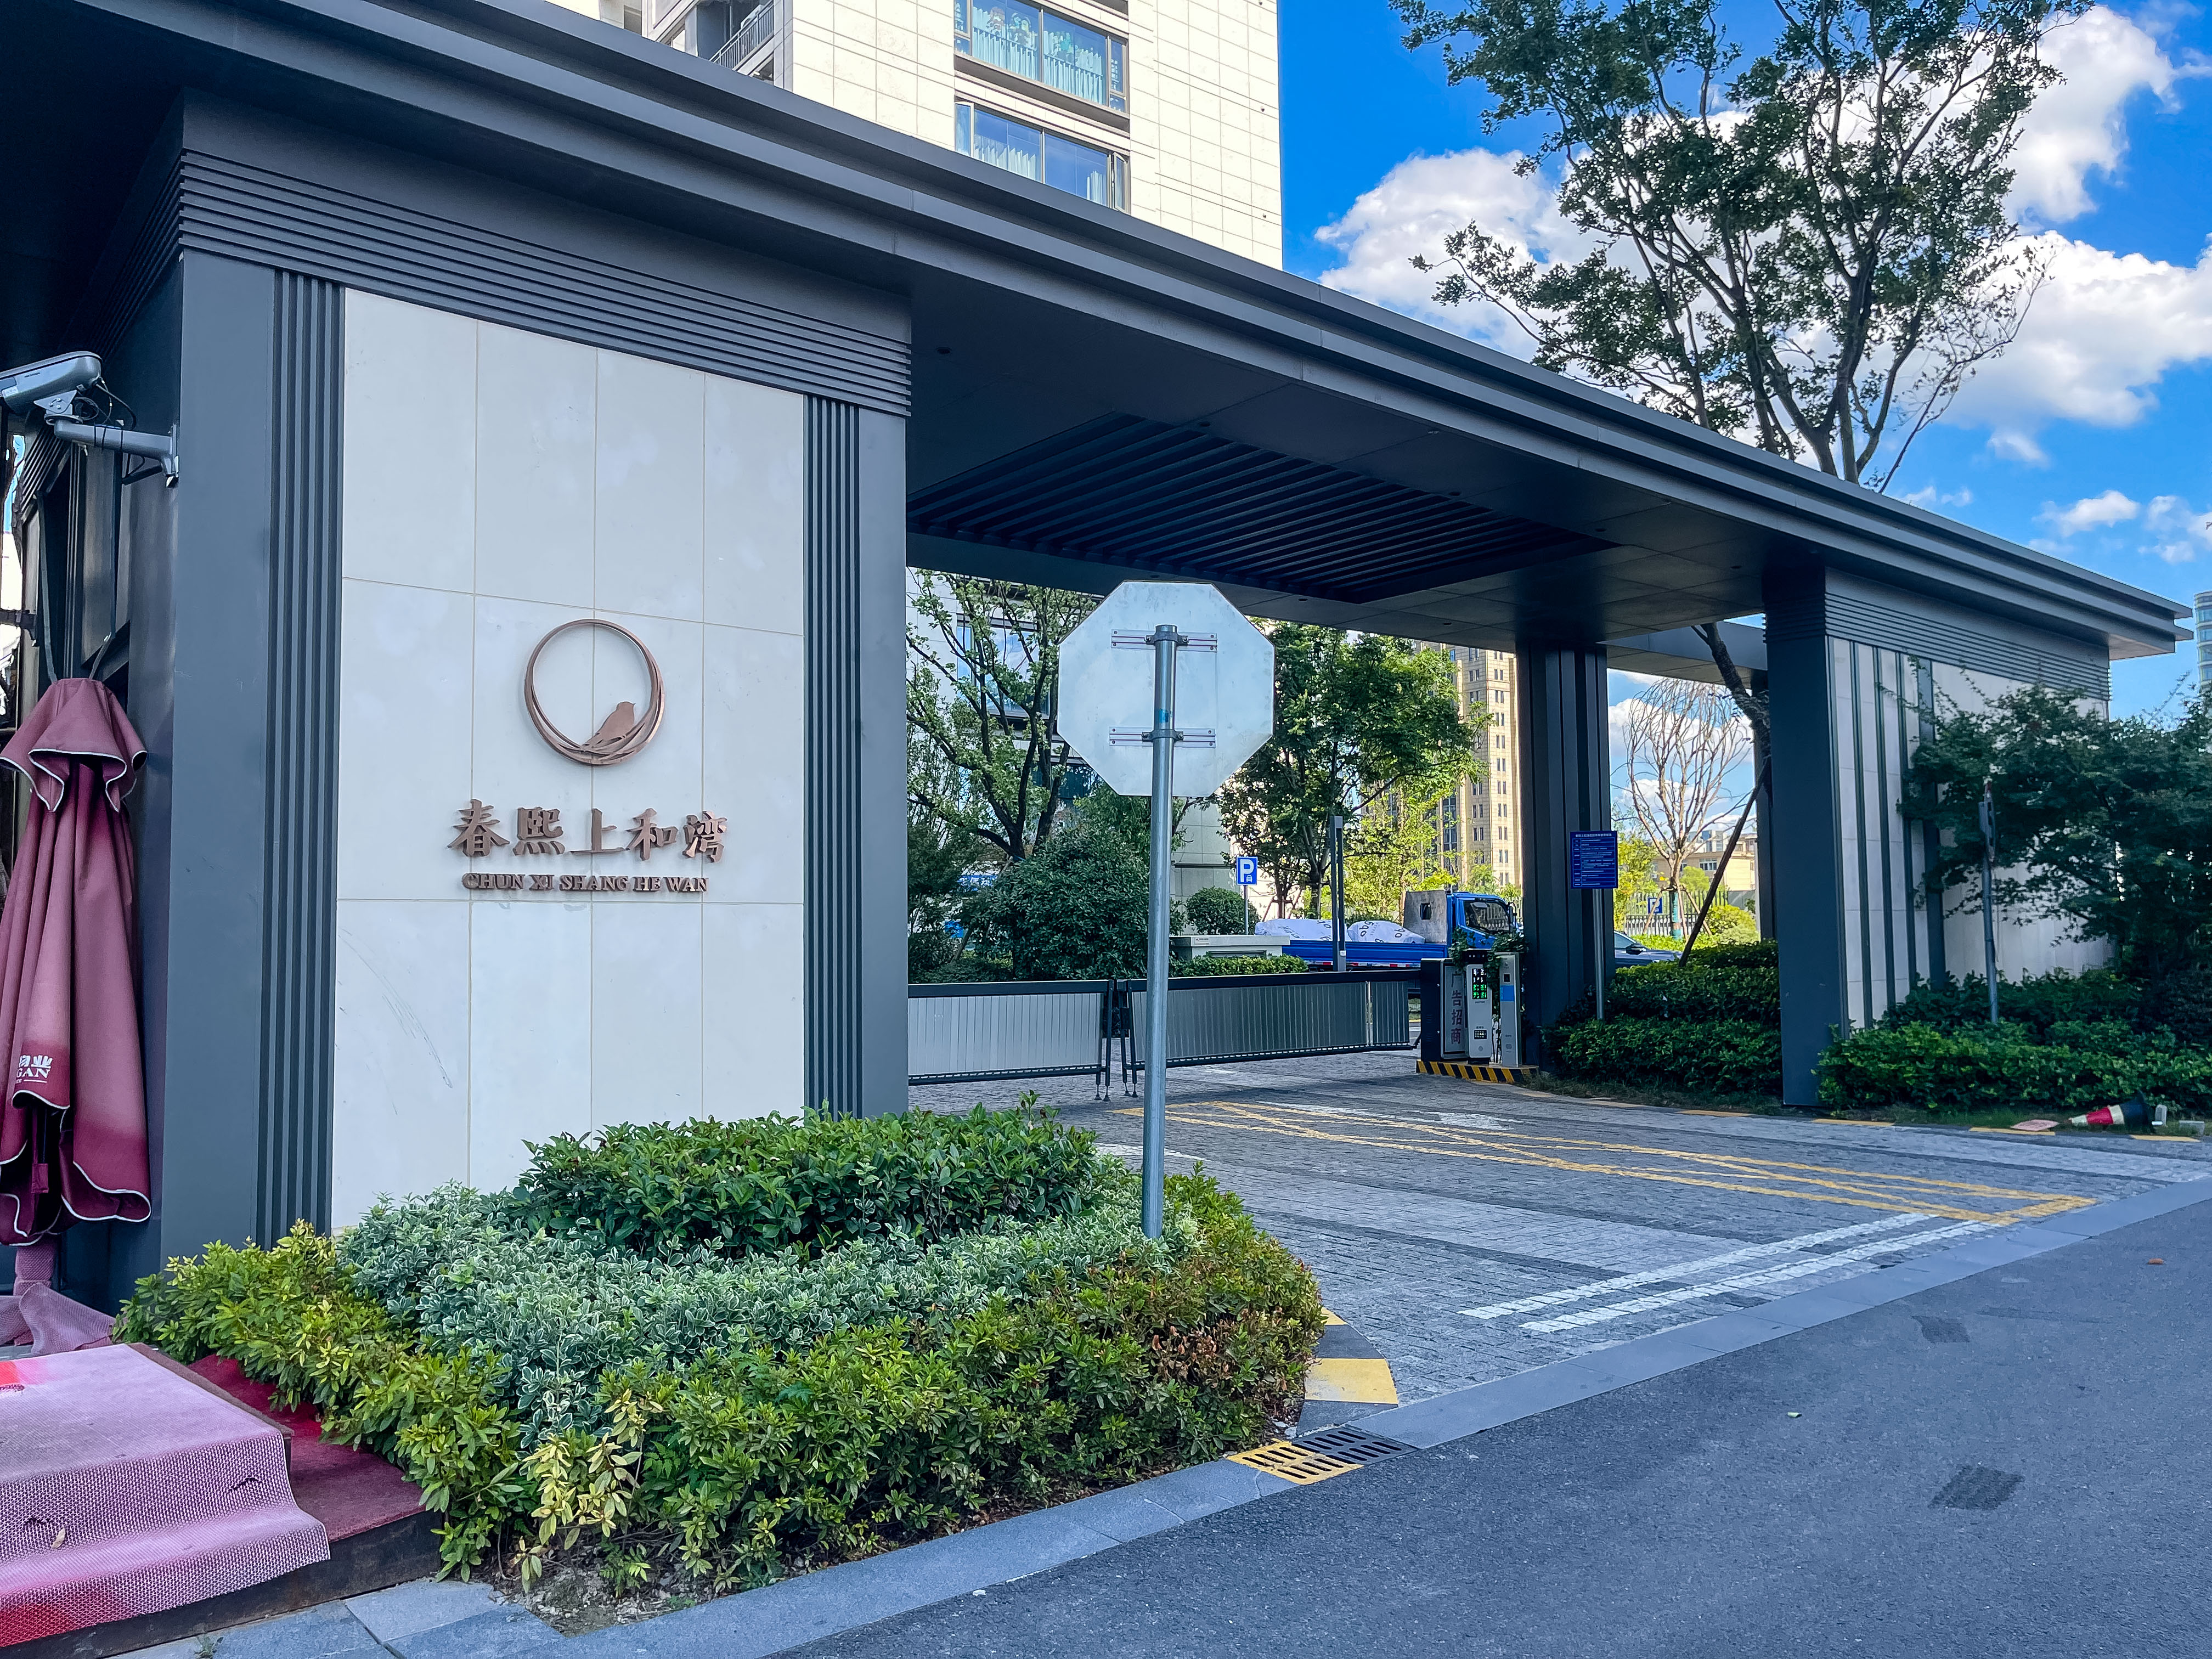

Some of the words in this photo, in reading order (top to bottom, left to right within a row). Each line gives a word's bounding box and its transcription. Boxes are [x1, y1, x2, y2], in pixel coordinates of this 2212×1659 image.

[447, 799, 727, 862] 春熙上和湾
[462, 873, 525, 889] CHUN
[529, 874, 555, 890] XI
[559, 875, 629, 891] SHANG
[633, 877, 661, 891] HE
[664, 877, 709, 892] WAN
[1240, 859, 1254, 882] P
[1451, 970, 1463, 1045] 广告招商
